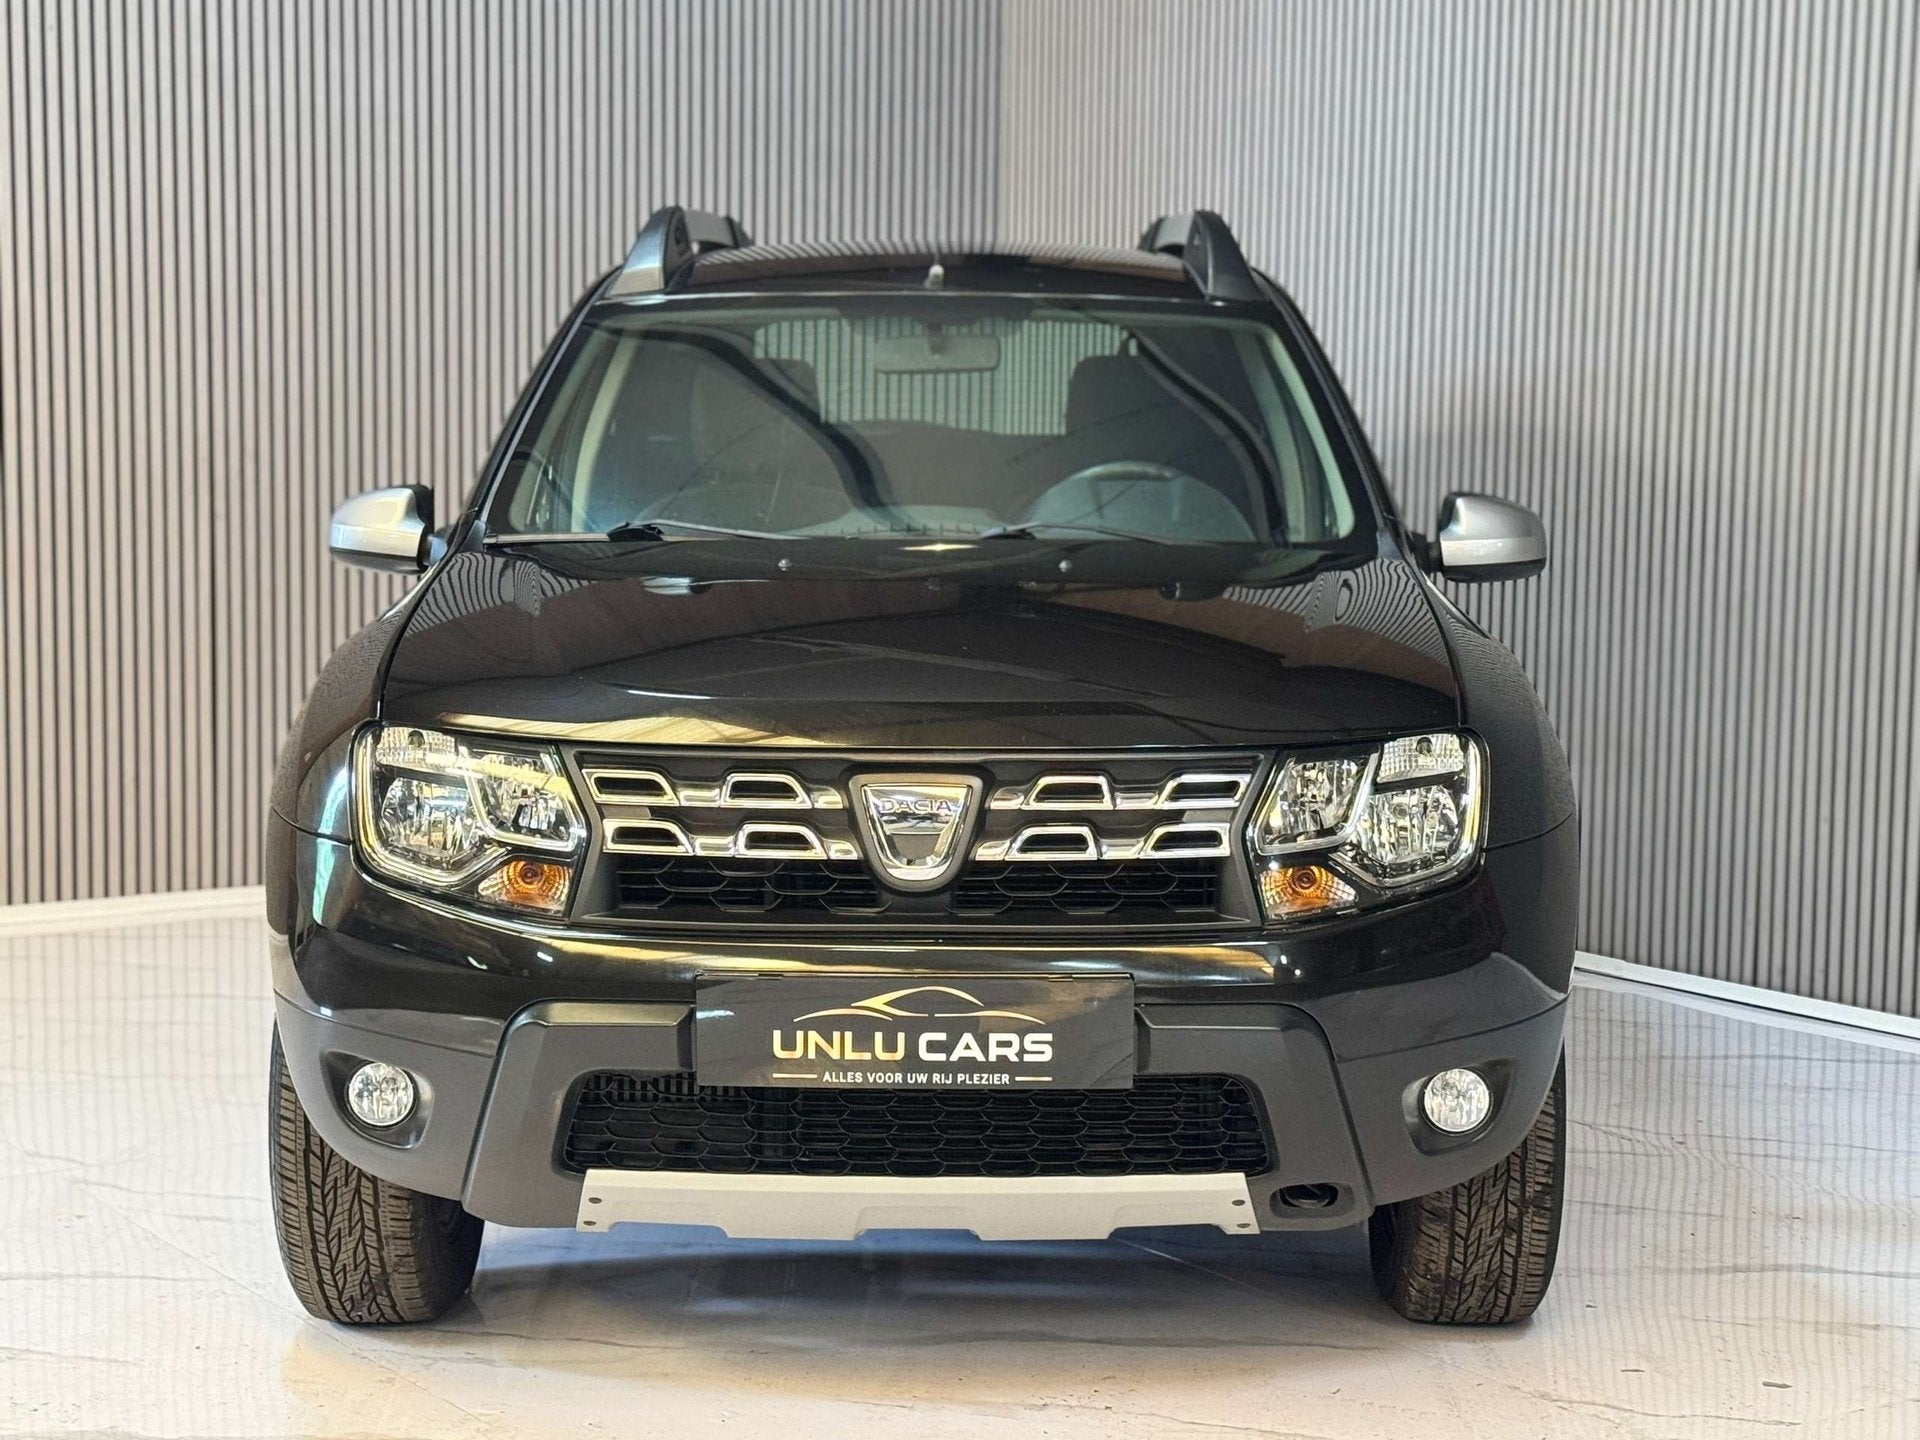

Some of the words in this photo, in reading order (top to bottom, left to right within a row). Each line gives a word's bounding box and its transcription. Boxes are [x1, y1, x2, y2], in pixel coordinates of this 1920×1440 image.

[879, 799, 952, 813] DACIA
[772, 1029, 905, 1061] UNLU
[918, 1032, 1053, 1062] CARS
[822, 1071, 863, 1083] ALLES
[867, 1072, 901, 1084] VOOR
[907, 1072, 928, 1084] UW
[932, 1073, 953, 1085] RIJ
[957, 1073, 1010, 1085] PLEZIER
